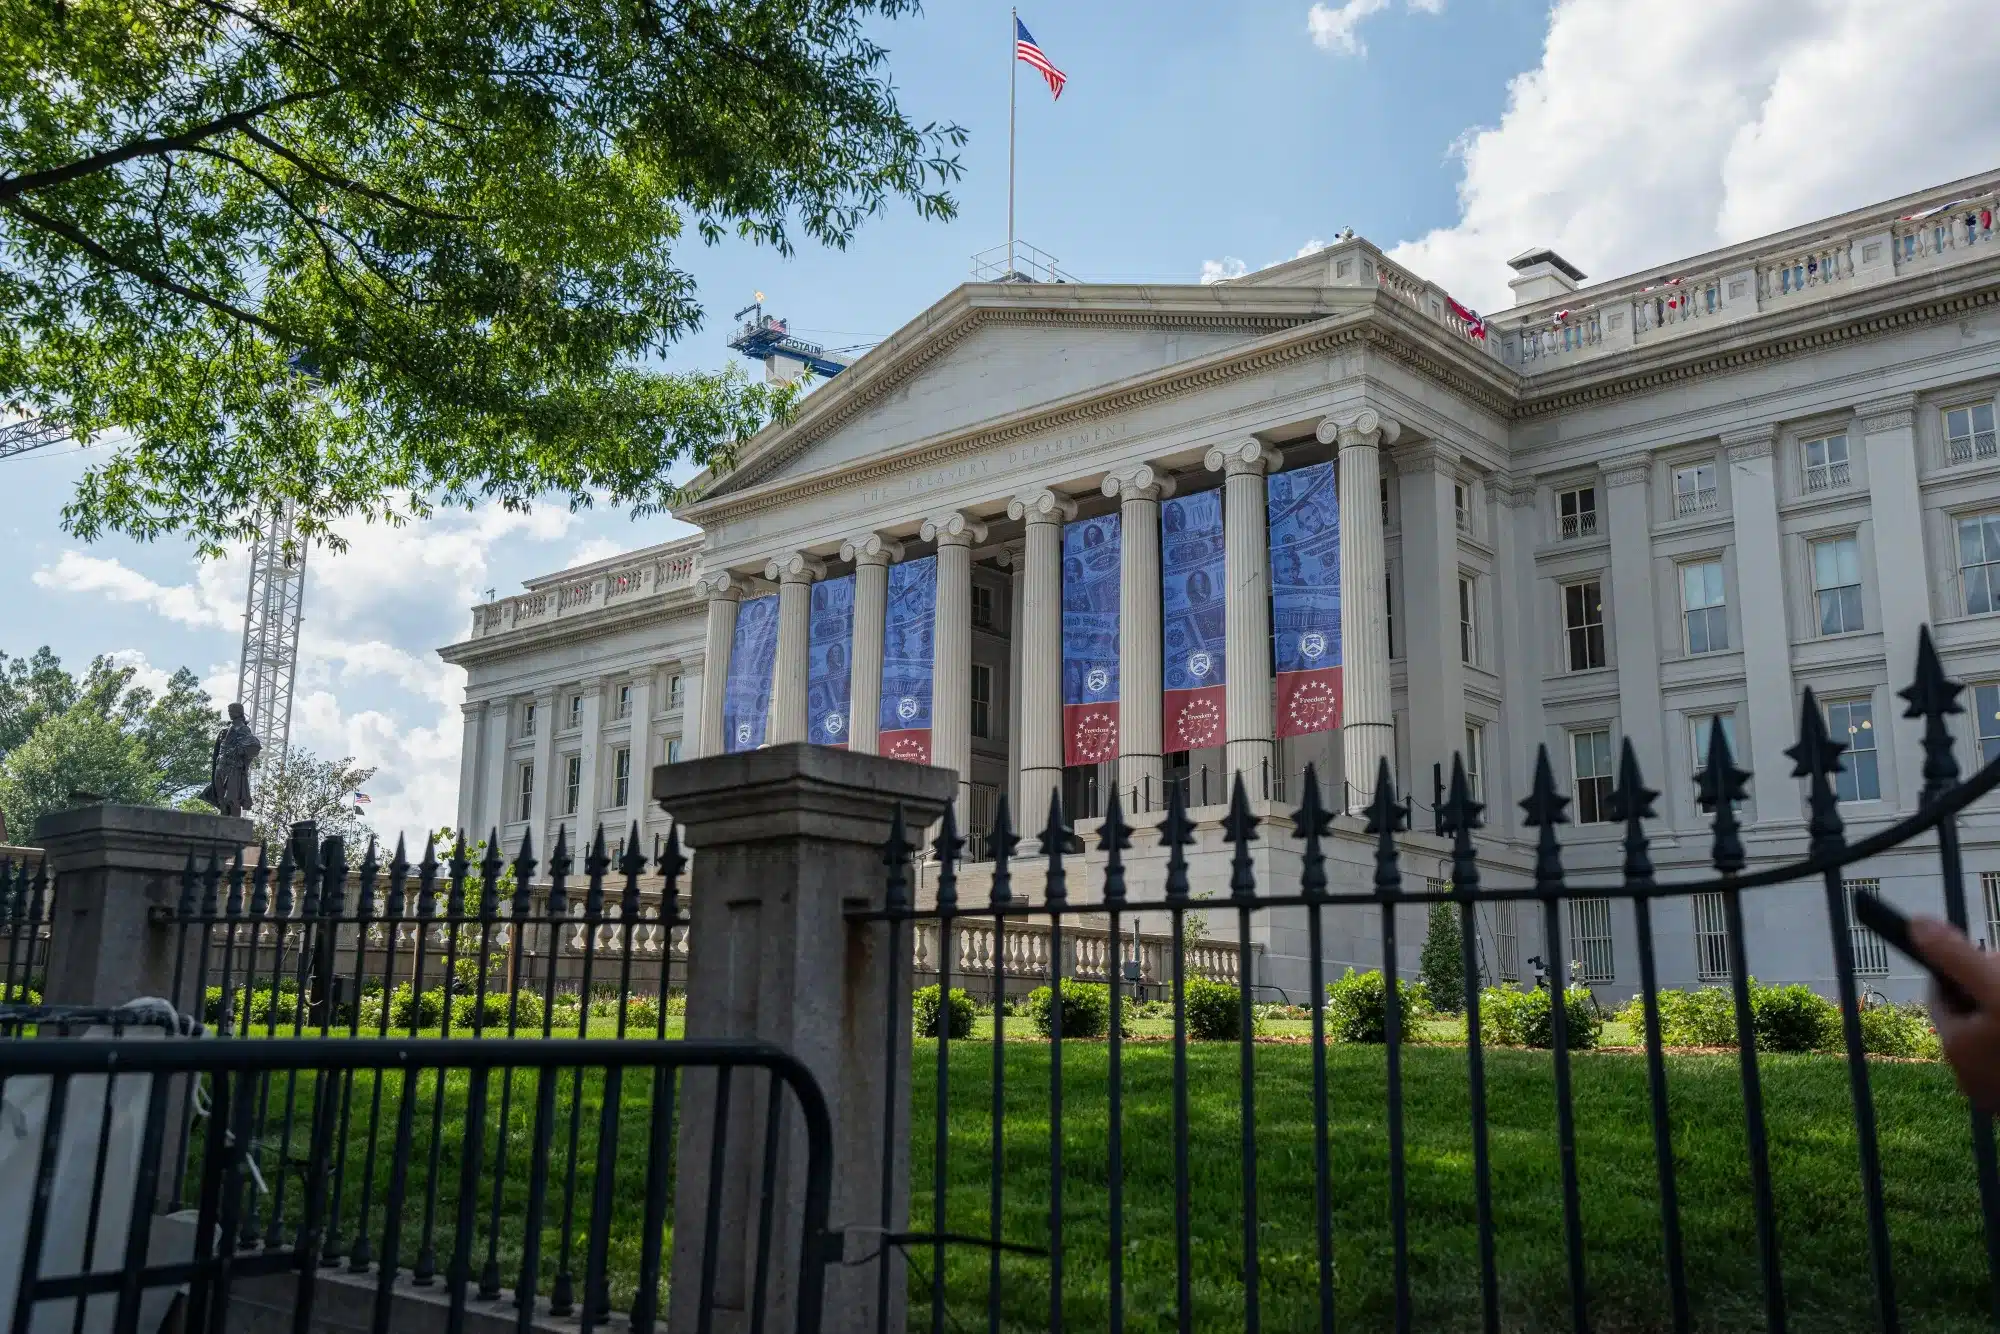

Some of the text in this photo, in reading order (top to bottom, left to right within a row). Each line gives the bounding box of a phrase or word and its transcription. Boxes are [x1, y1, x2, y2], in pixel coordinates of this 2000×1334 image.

[785, 338, 821, 354] POTAIN
[862, 423, 1129, 503] THE TREASURY DEPARTMENT
[1299, 696, 1327, 704] Freedom
[1301, 702, 1326, 718] 250
[1189, 719, 1211, 733] 250
